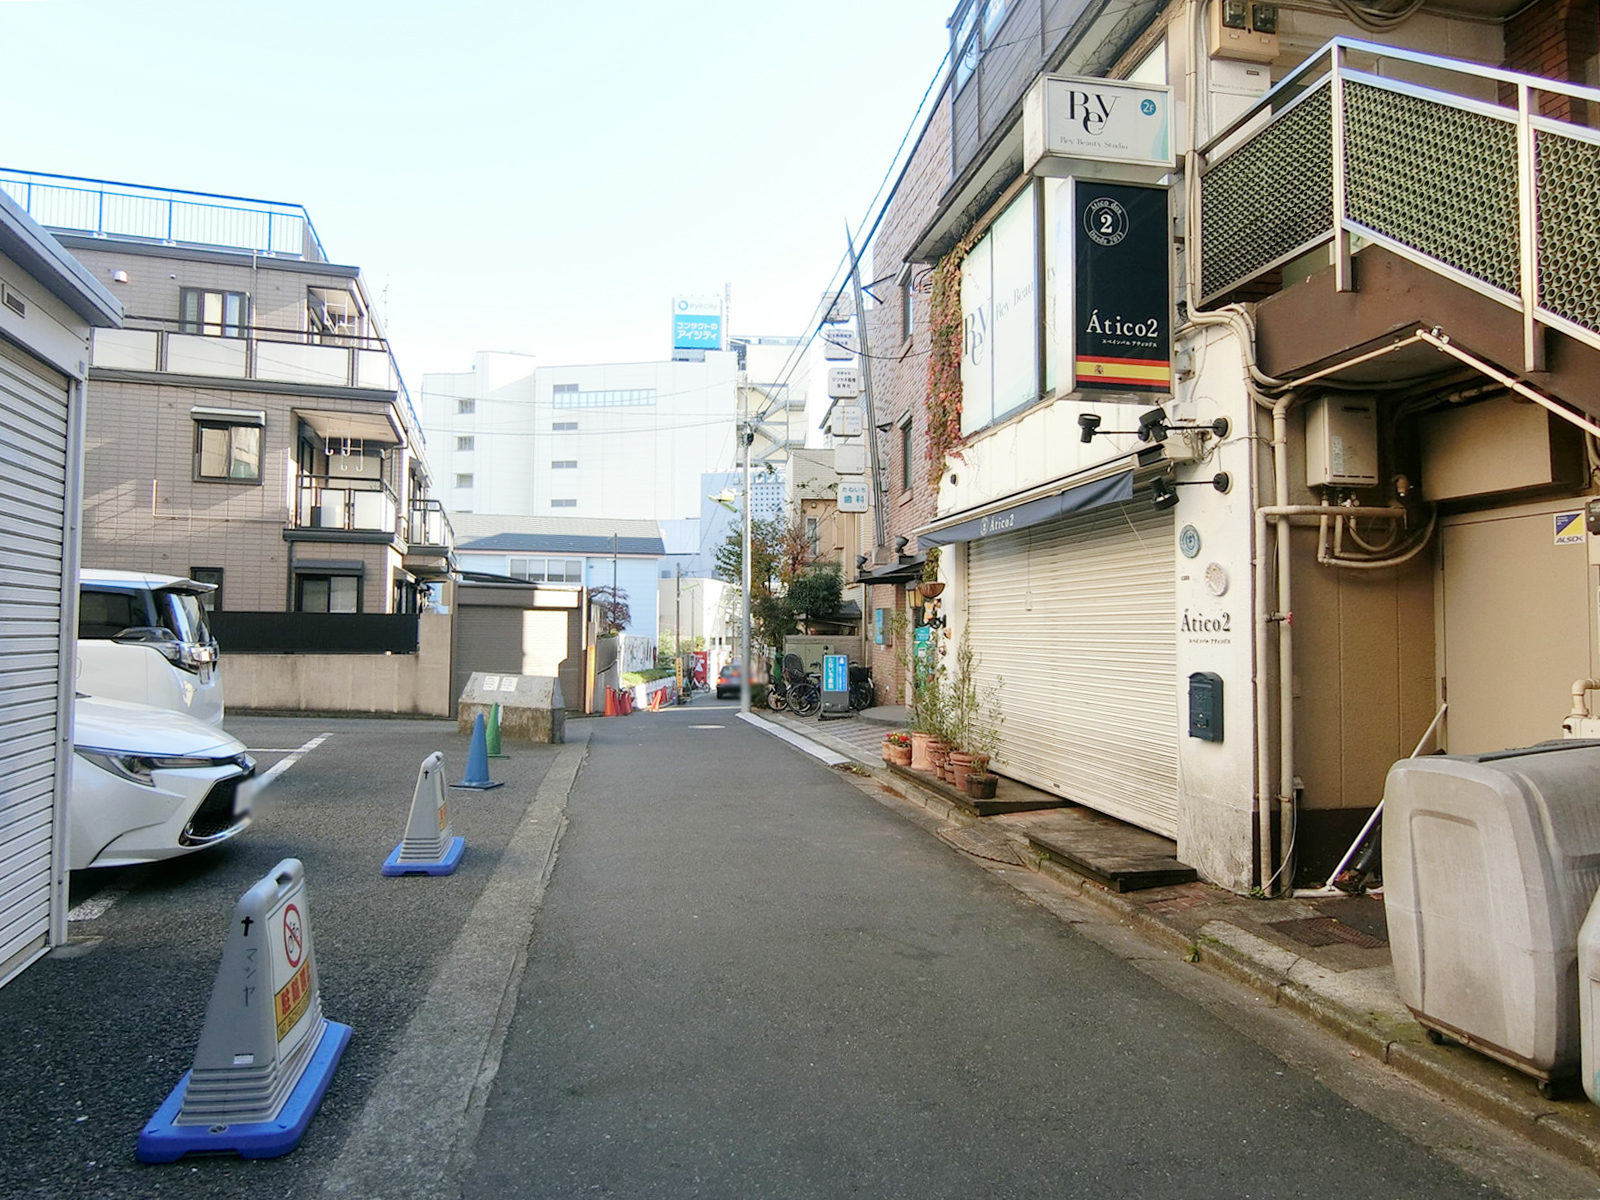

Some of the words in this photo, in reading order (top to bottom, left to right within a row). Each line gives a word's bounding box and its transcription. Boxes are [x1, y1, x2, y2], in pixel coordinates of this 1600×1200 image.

[1142, 101, 1155, 113] 2F
[1060, 136, 1074, 144] Rey
[1077, 138, 1101, 148] Beauty
[1103, 141, 1128, 150] Studio
[1100, 214, 1113, 233] 2
[677, 322, 718, 331] コンタクトの
[1085, 309, 1159, 338] Ático2
[677, 330, 718, 340] アイシティ
[989, 514, 1015, 532] Ático2
[1181, 608, 1230, 632] Ático2
